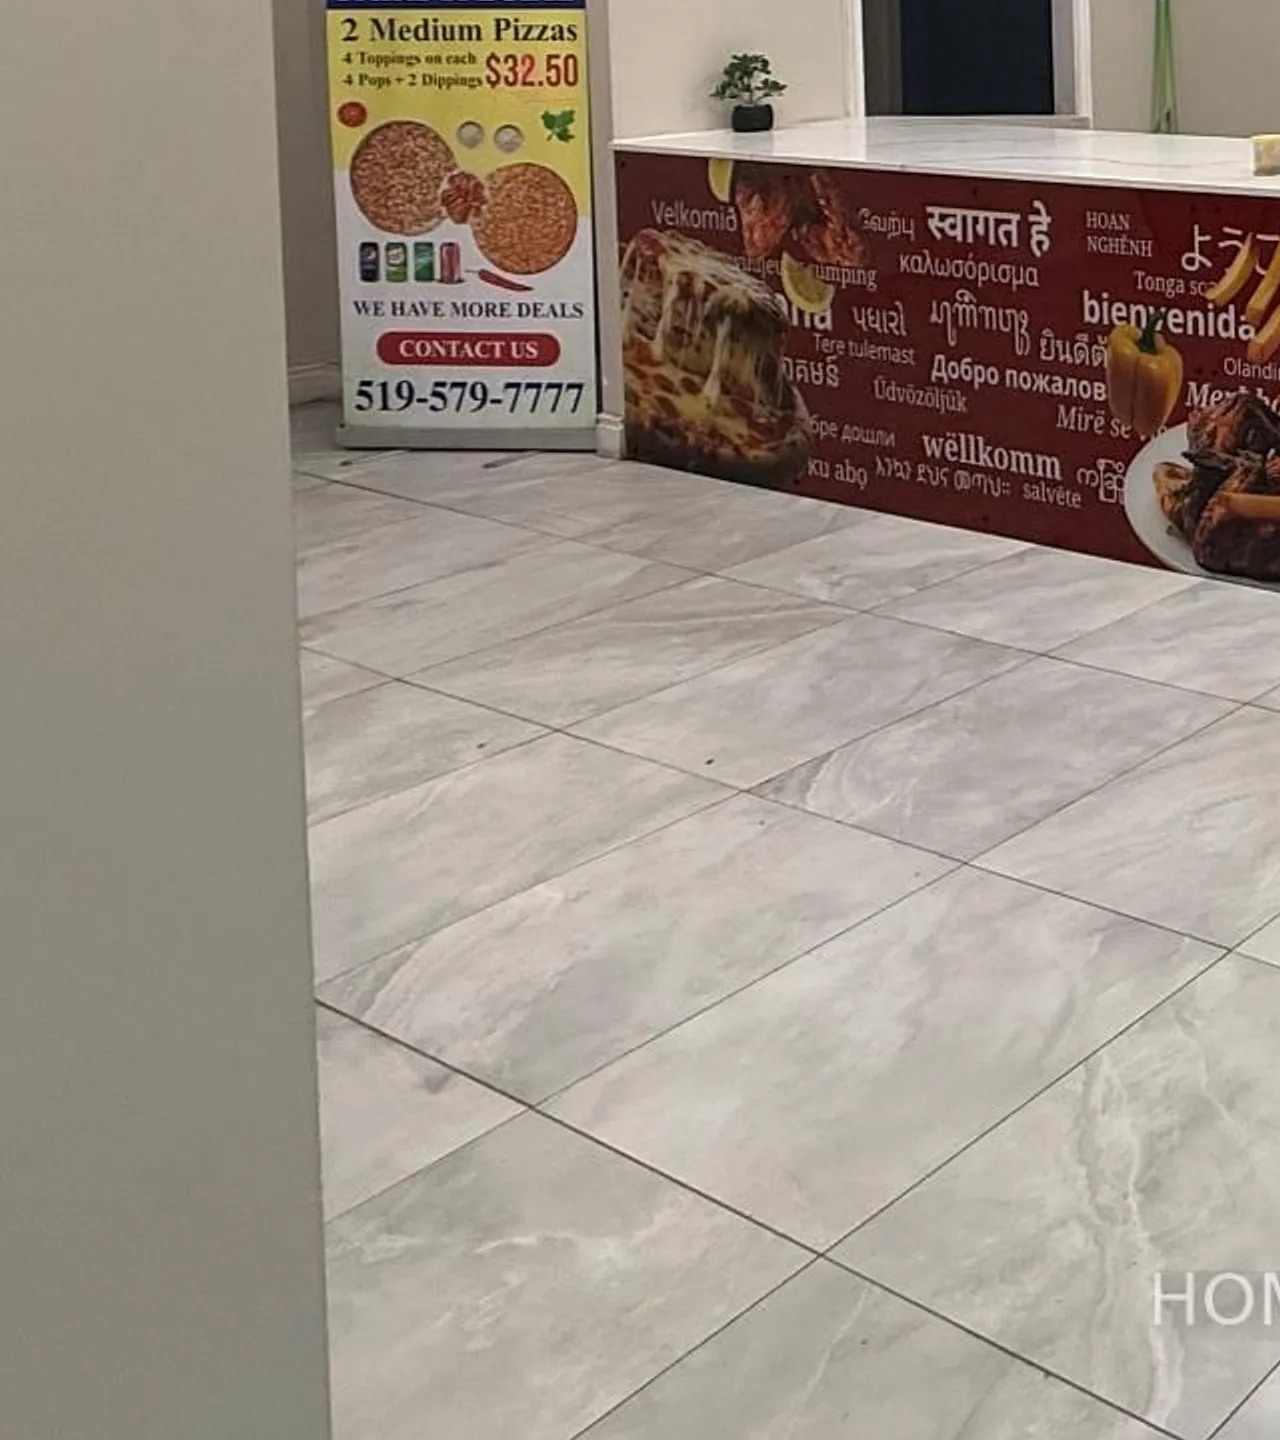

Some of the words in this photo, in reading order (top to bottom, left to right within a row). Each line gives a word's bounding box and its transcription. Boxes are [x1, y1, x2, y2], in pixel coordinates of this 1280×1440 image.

[341, 18, 359, 42] 2
[369, 18, 482, 42] Medium
[493, 18, 578, 42] Pizzas
[358, 51, 421, 69] Toppings
[425, 54, 442, 65] on
[446, 52, 477, 65] each
[485, 52, 578, 89] $32.50
[358, 74, 392, 89] Pops
[408, 74, 418, 86] 2
[422, 74, 483, 90] Dippings
[926, 206, 1021, 248] स्वागत
[1086, 211, 1130, 231] HOAN
[1134, 271, 1185, 298] Tonga
[353, 300, 386, 317] WE
[391, 300, 446, 318] HAVE
[451, 302, 511, 318] MORE
[517, 302, 584, 319] DEALS
[400, 340, 504, 359] CONTACT
[512, 341, 538, 359] US
[813, 333, 845, 356] Tere
[850, 339, 917, 366] tulemast
[931, 355, 999, 389] Добро
[1005, 369, 1107, 402] пожалов
[355, 379, 584, 413] 519-579-7777
[922, 432, 1064, 482] wëllkomm
